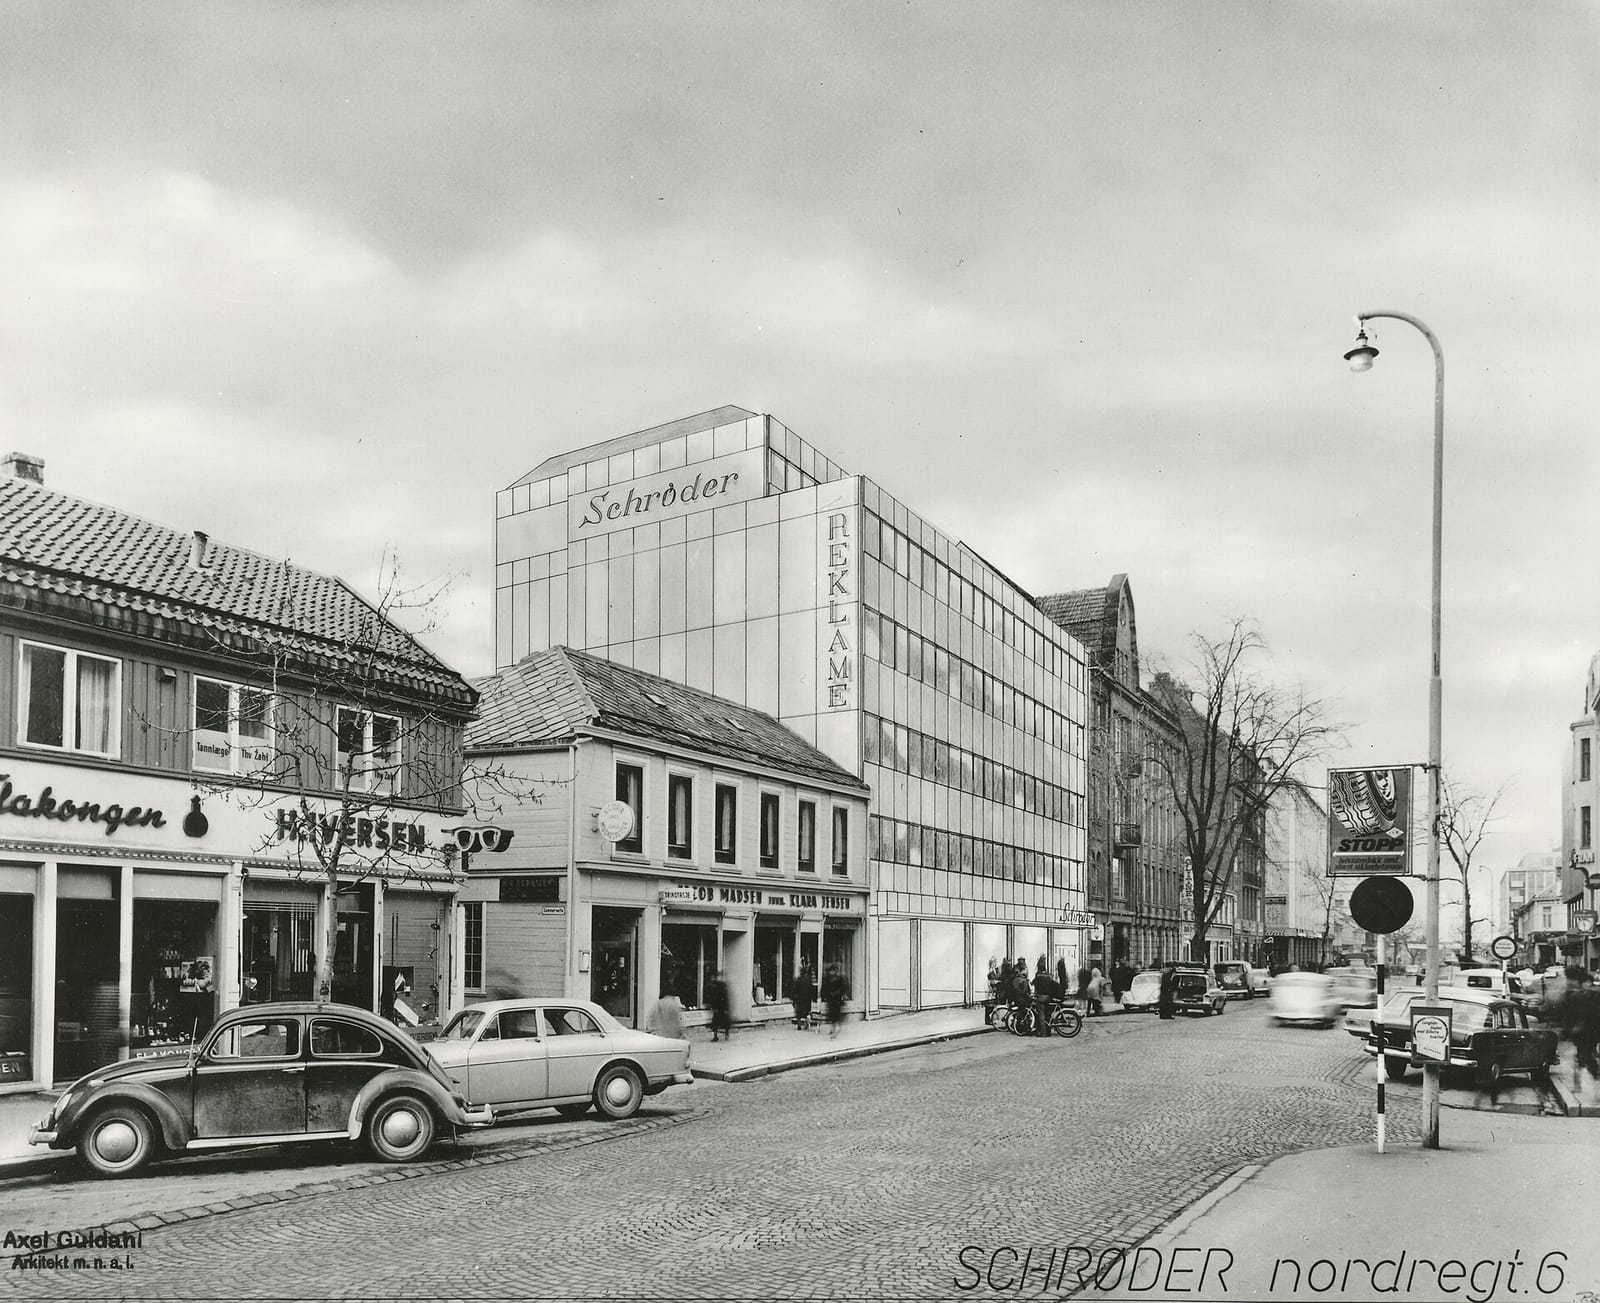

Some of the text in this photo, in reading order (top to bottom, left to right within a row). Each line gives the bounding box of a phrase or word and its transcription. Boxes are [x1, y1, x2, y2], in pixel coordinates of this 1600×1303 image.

[827, 512, 851, 708] REKLAME
[1338, 838, 1404, 852] STOPP
[720, 888, 763, 905] MADSEN
[789, 894, 818, 908] KLARA
[821, 895, 851, 910] JENSEN
